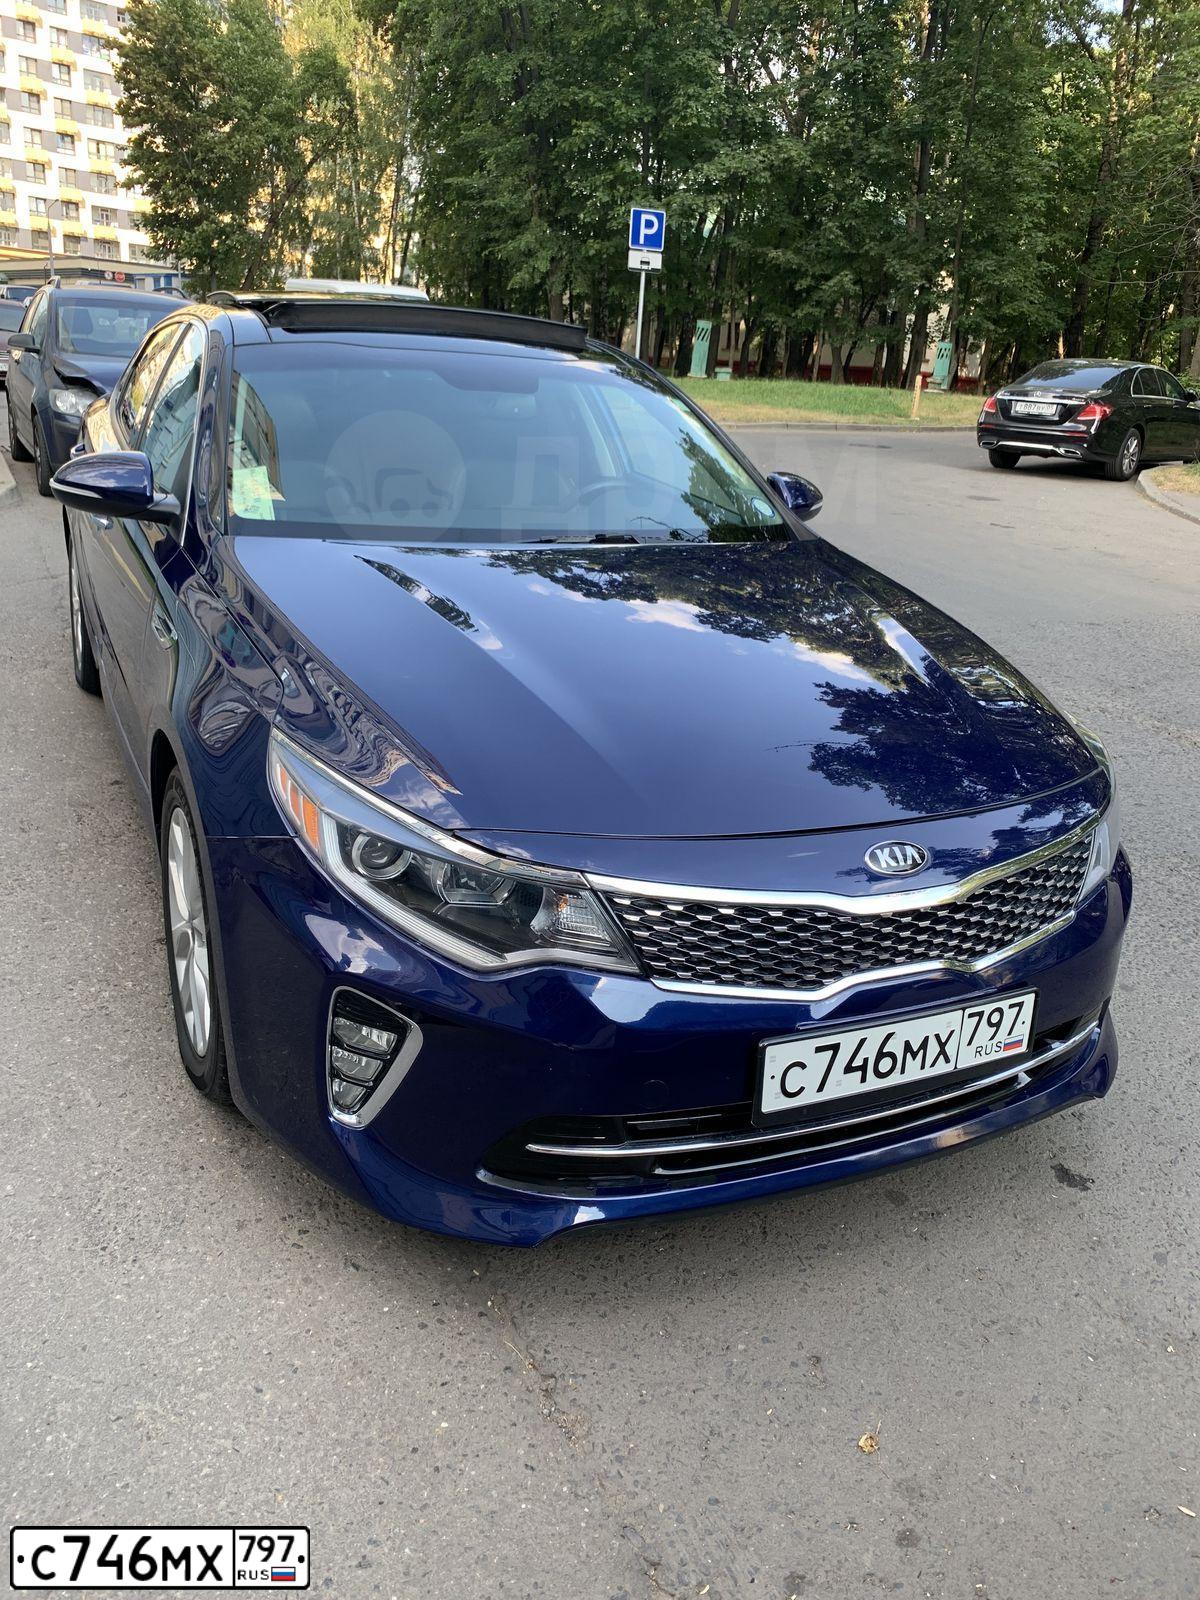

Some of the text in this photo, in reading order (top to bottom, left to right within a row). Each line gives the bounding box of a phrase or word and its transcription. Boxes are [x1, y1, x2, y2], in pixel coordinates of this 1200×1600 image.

[639, 213, 659, 245] P
[874, 844, 923, 869] KIA
[780, 1001, 1026, 1099] С746МХ 797
[974, 1041, 1003, 1059] RUS
